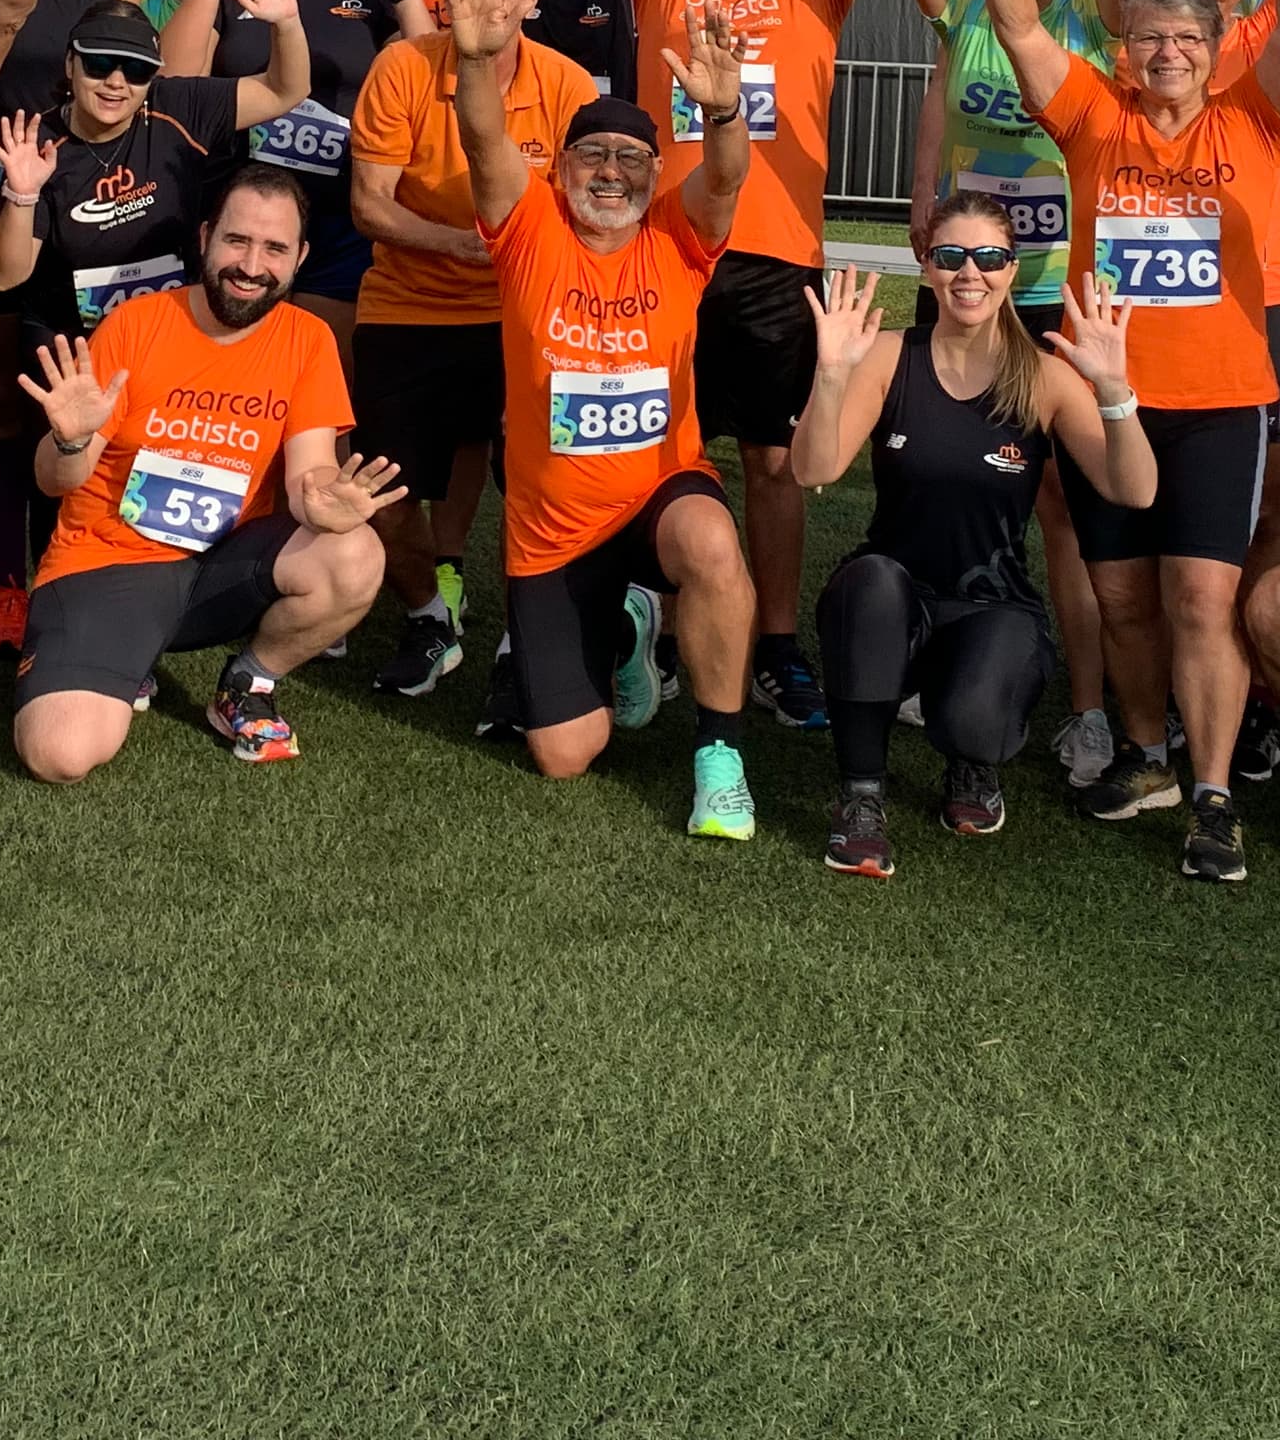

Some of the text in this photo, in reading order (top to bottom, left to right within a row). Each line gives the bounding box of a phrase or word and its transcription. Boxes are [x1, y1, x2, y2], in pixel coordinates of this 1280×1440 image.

[269, 118, 346, 160] 365
[115, 181, 158, 205] marcelo
[999, 183, 1020, 192] SESI
[115, 194, 155, 217] batista
[1096, 185, 1222, 217] batista
[1144, 224, 1169, 234] SESI
[119, 268, 141, 278] SESI
[1123, 249, 1219, 288] 736
[548, 307, 649, 354] batista
[585, 358, 602, 372] de
[600, 381, 624, 391] SESI
[166, 388, 288, 422] marcelo
[145, 408, 261, 452] batista
[578, 398, 669, 440] 886
[187, 449, 204, 462] de
[180, 467, 205, 480] SESI
[161, 488, 223, 534] 53
